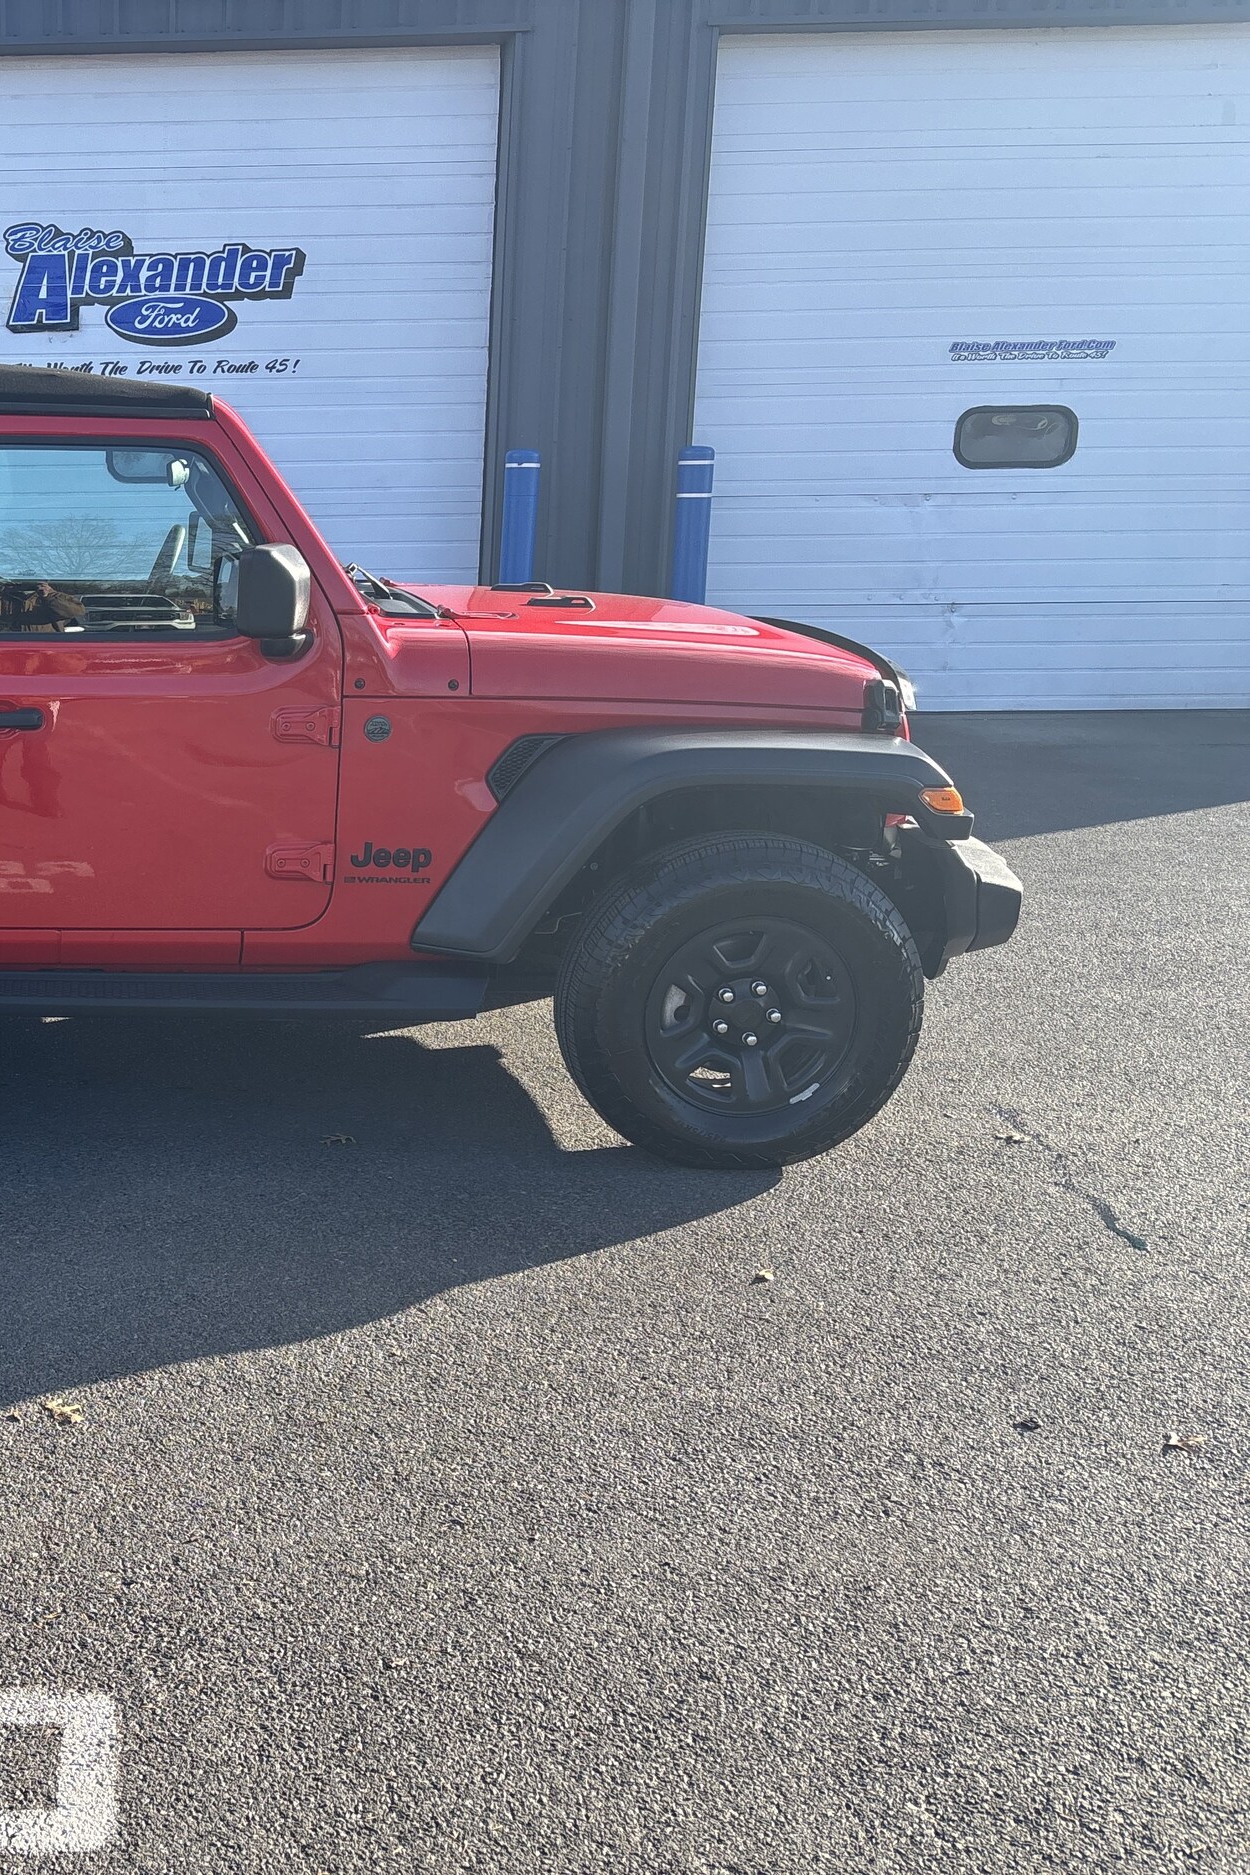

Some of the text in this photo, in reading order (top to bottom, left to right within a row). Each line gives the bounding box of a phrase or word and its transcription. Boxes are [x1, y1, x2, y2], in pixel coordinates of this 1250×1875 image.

[4, 223, 126, 254] Blaise
[9, 245, 297, 326] Alexander
[134, 302, 200, 330] Ford
[949, 341, 991, 353] Blaise
[991, 340, 1056, 352] Alexander
[967, 352, 998, 361] Worth
[998, 352, 1017, 361] The
[1017, 352, 1045, 360] Drive
[1046, 351, 1059, 360] To
[1059, 351, 1088, 360] Route
[1088, 350, 1109, 359] 45!
[99, 360, 128, 376] The
[136, 360, 183, 375] Drive
[188, 360, 207, 374] To
[213, 359, 260, 374] Route
[265, 358, 301, 374] 45!
[351, 842, 432, 873] Jeep
[356, 876, 431, 884] WRANGLER
